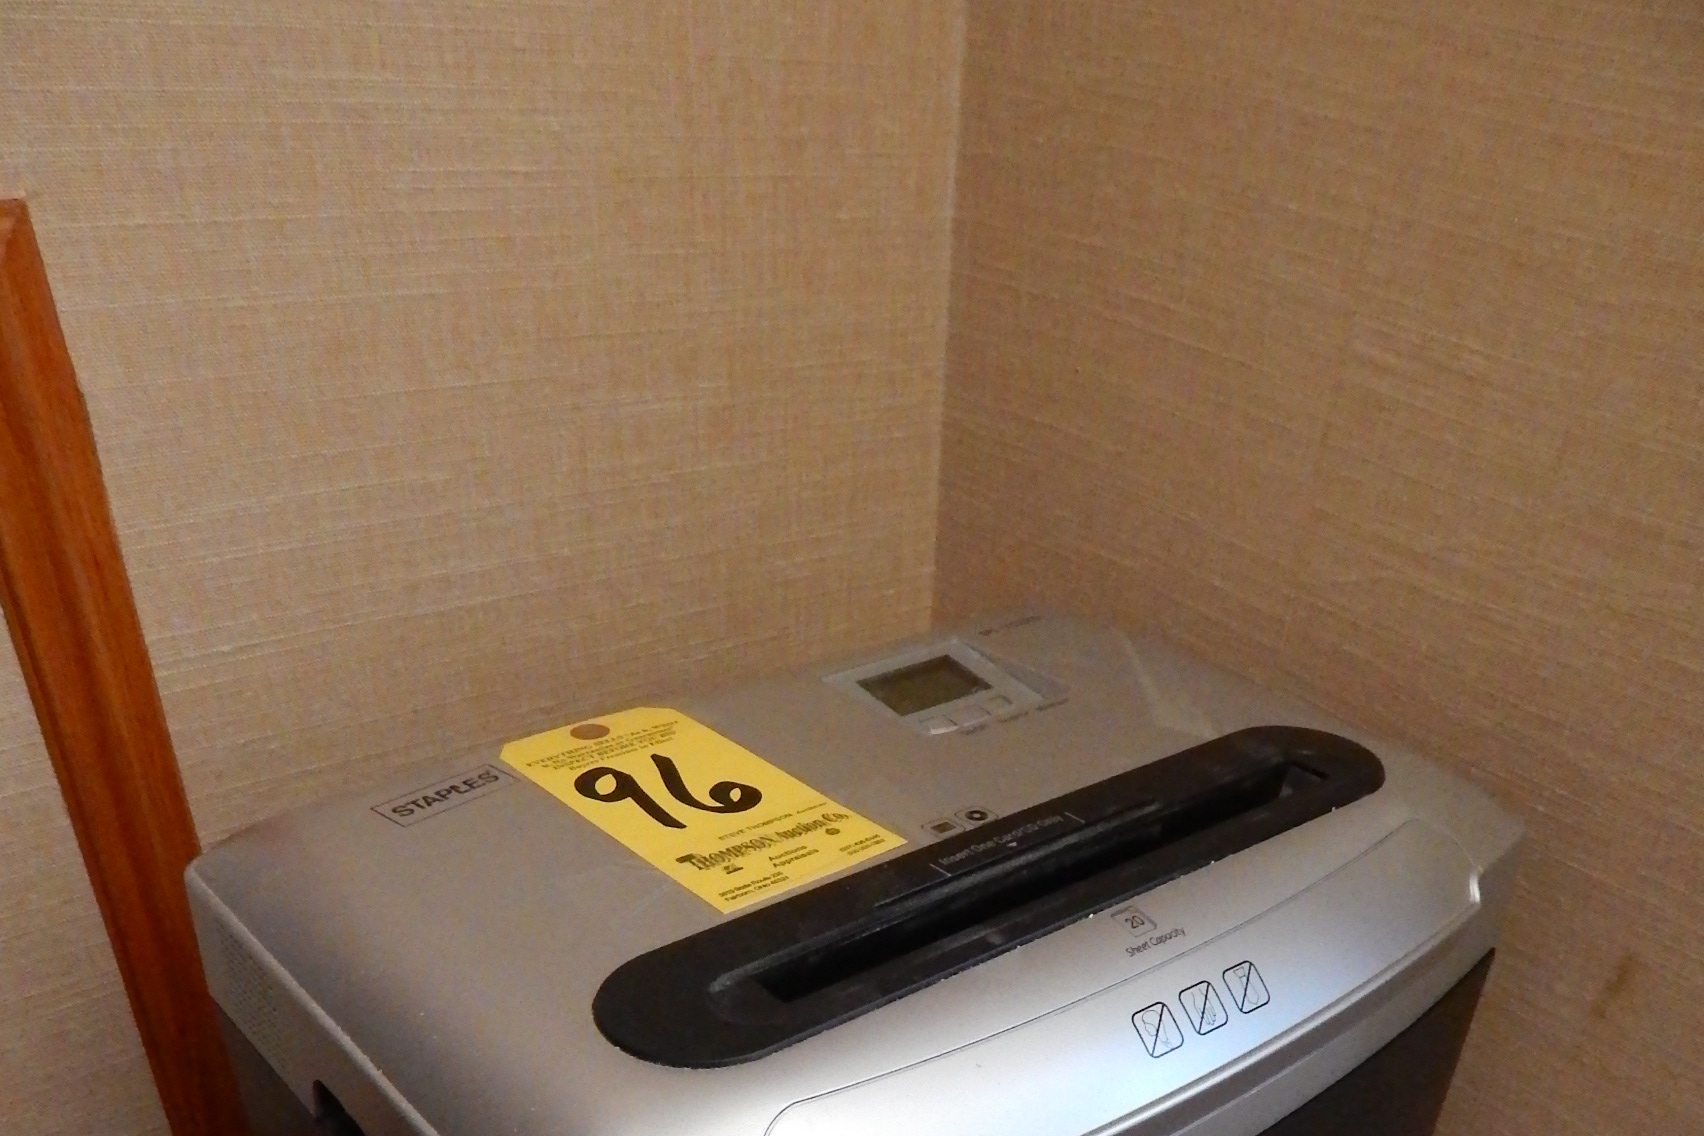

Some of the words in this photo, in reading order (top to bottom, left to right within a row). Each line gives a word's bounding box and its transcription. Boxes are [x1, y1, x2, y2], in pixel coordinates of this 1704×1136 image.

[391, 769, 500, 817] STAPLES
[574, 753, 762, 829] 96
[718, 829, 744, 841] STEVE
[746, 813, 793, 831] THOMPSON
[675, 834, 777, 871] THOMPSON
[775, 818, 827, 841] Auction
[768, 845, 807, 861] Auctions
[772, 848, 819, 868] Appraisals
[1125, 916, 1145, 929] 20
[1126, 941, 1151, 957] Sheet
[1150, 927, 1186, 945] Capacity
